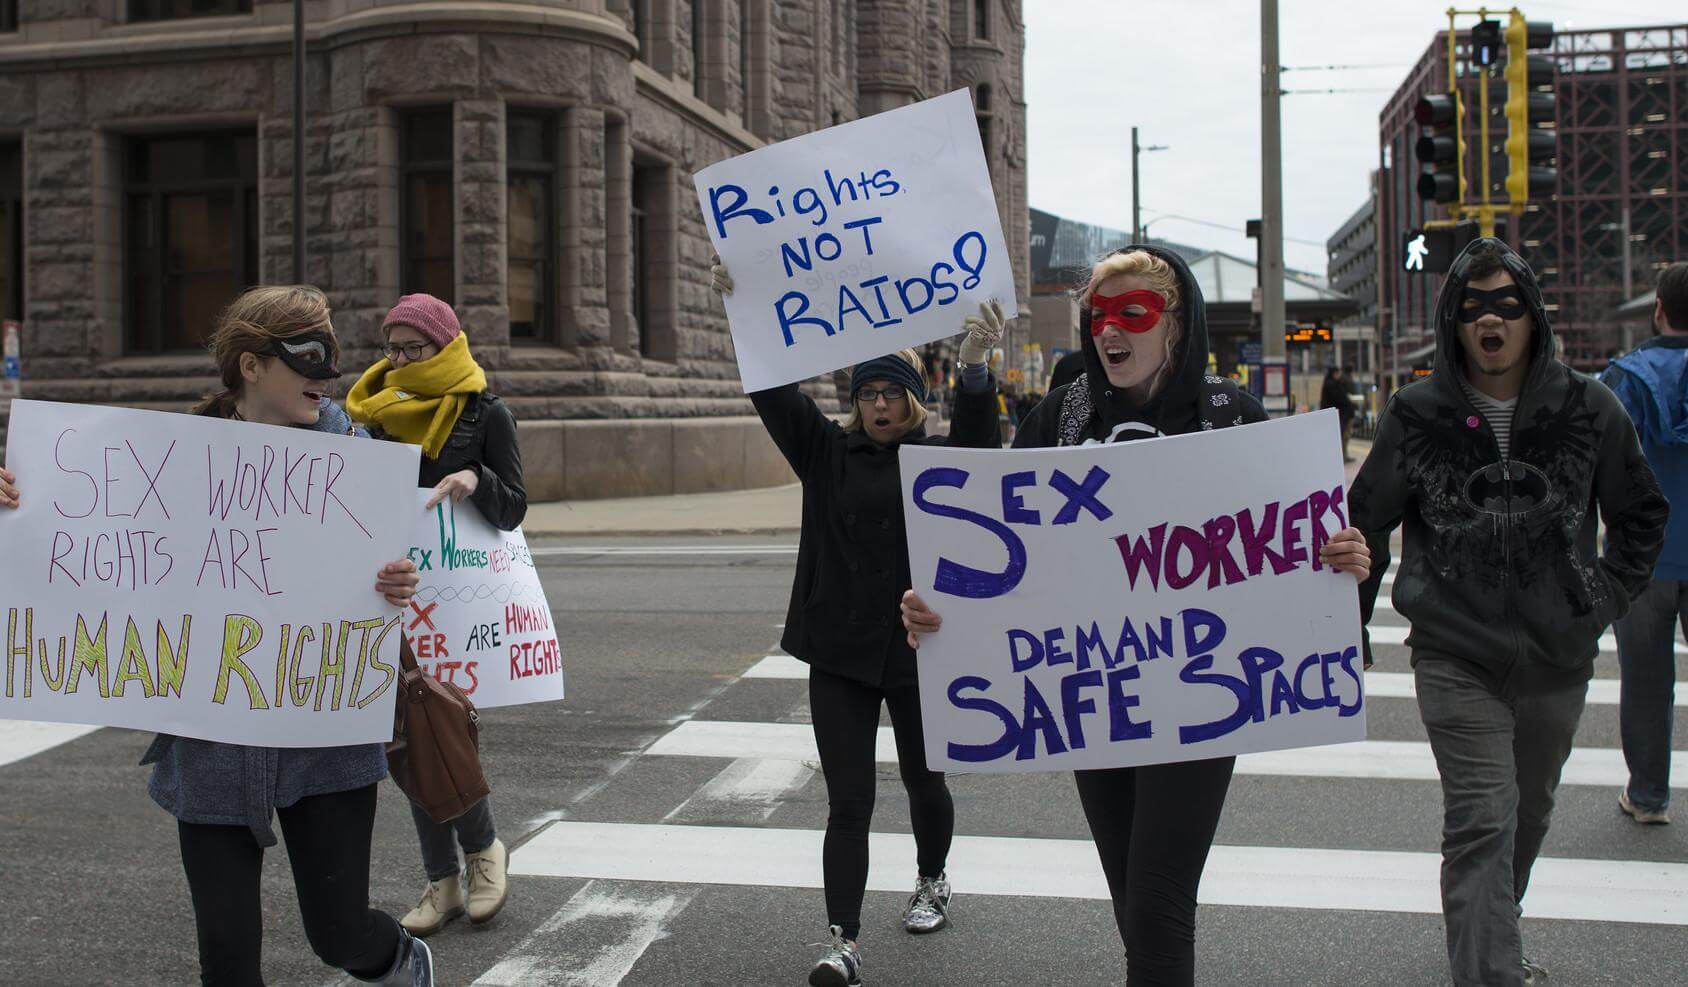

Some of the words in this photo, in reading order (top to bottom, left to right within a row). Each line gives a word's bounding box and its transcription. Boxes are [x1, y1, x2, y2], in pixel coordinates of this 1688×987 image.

[709, 169, 900, 239] Rights
[780, 216, 882, 278] NOT
[774, 231, 987, 347] RAIDS!
[54, 428, 176, 520] SEX
[207, 443, 373, 539] WORKER
[49, 530, 174, 590] RIGHTS
[197, 527, 283, 596] ARE
[437, 501, 488, 571] WORKERS
[912, 465, 1114, 599] SEX
[1109, 485, 1348, 592] WORKERS
[466, 622, 501, 651] ARE
[504, 603, 549, 635] HUMAN
[1006, 608, 1226, 673] DEMAND
[5, 607, 193, 699] HUMAN
[212, 613, 401, 712] RIGHTS
[947, 665, 1154, 762] SAFE
[1178, 645, 1362, 744] SPACES
